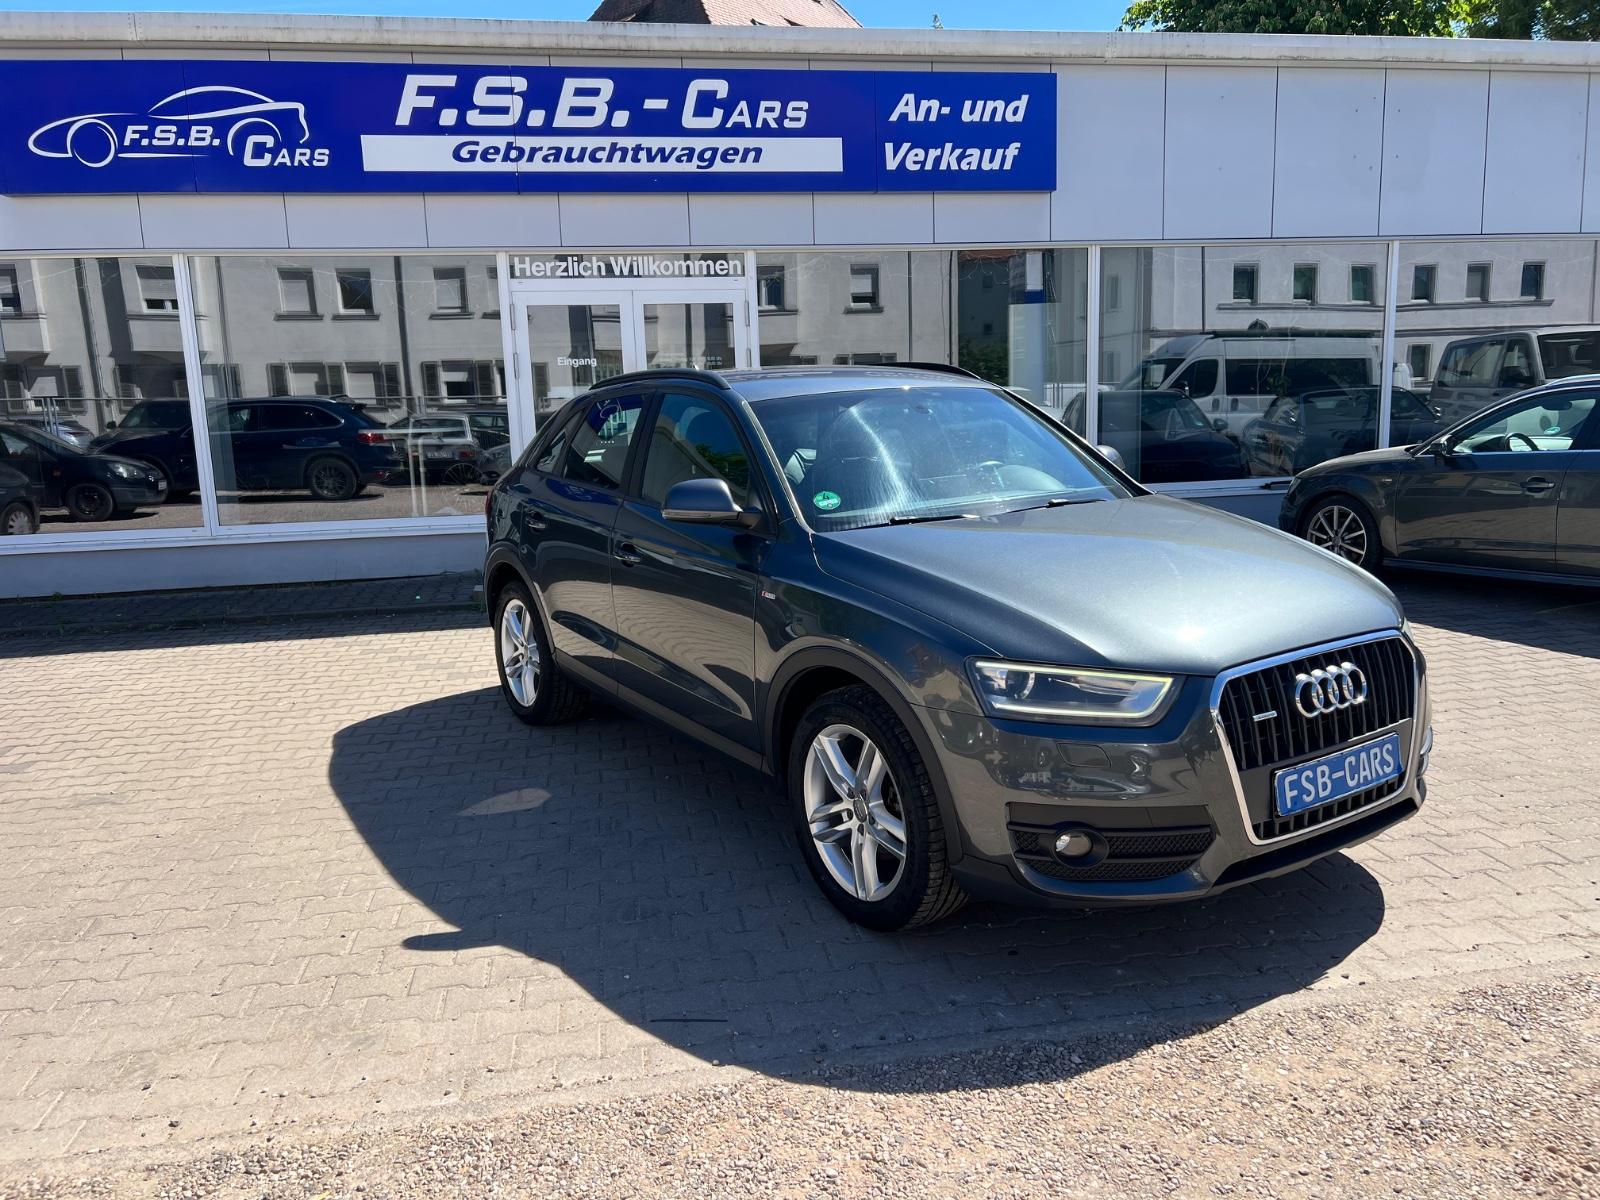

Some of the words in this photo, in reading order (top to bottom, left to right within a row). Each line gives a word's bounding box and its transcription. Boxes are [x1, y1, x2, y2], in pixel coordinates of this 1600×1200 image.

[888, 93, 951, 122] An-
[961, 94, 1029, 123] und
[123, 125, 221, 147] F.S.B.
[452, 140, 763, 170] Gebrauchtwagen
[884, 142, 1022, 171] Verkauf
[513, 256, 606, 277] Herzlich
[609, 256, 742, 277] Willkommen
[557, 356, 597, 368] Eingang
[1284, 743, 1394, 809] FSB-CARS
